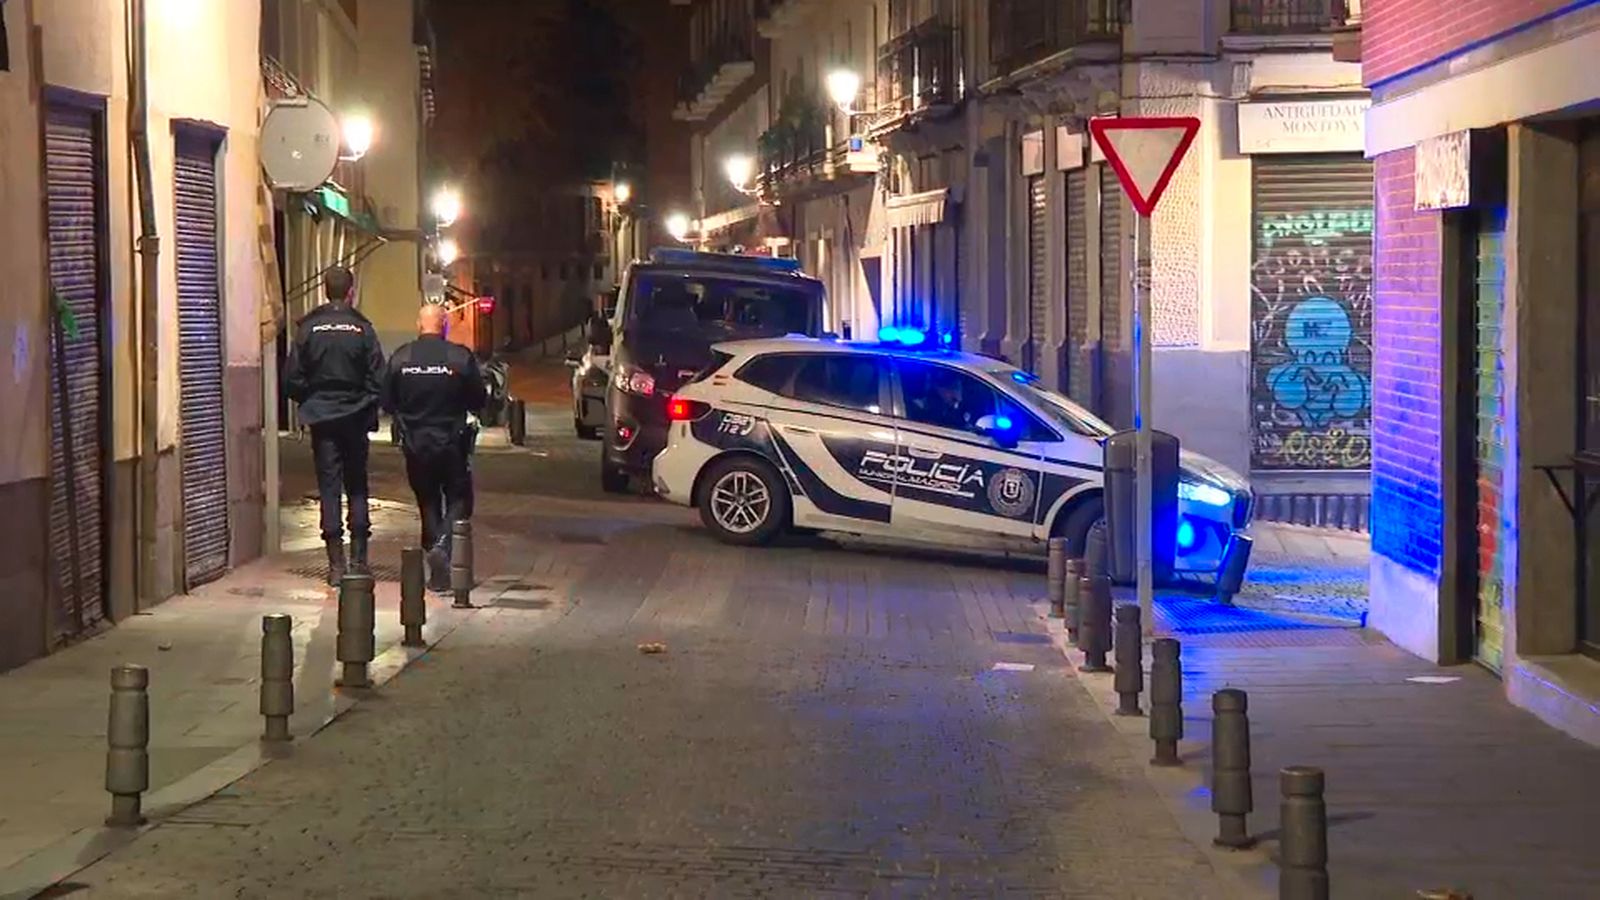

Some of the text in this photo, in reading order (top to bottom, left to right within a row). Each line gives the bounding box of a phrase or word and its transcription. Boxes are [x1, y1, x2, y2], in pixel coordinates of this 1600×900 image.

[1263, 104, 1367, 118] ANTIGUEDAD
[1280, 119, 1360, 133] MONTOYA
[912, 475, 962, 491] MADRID
